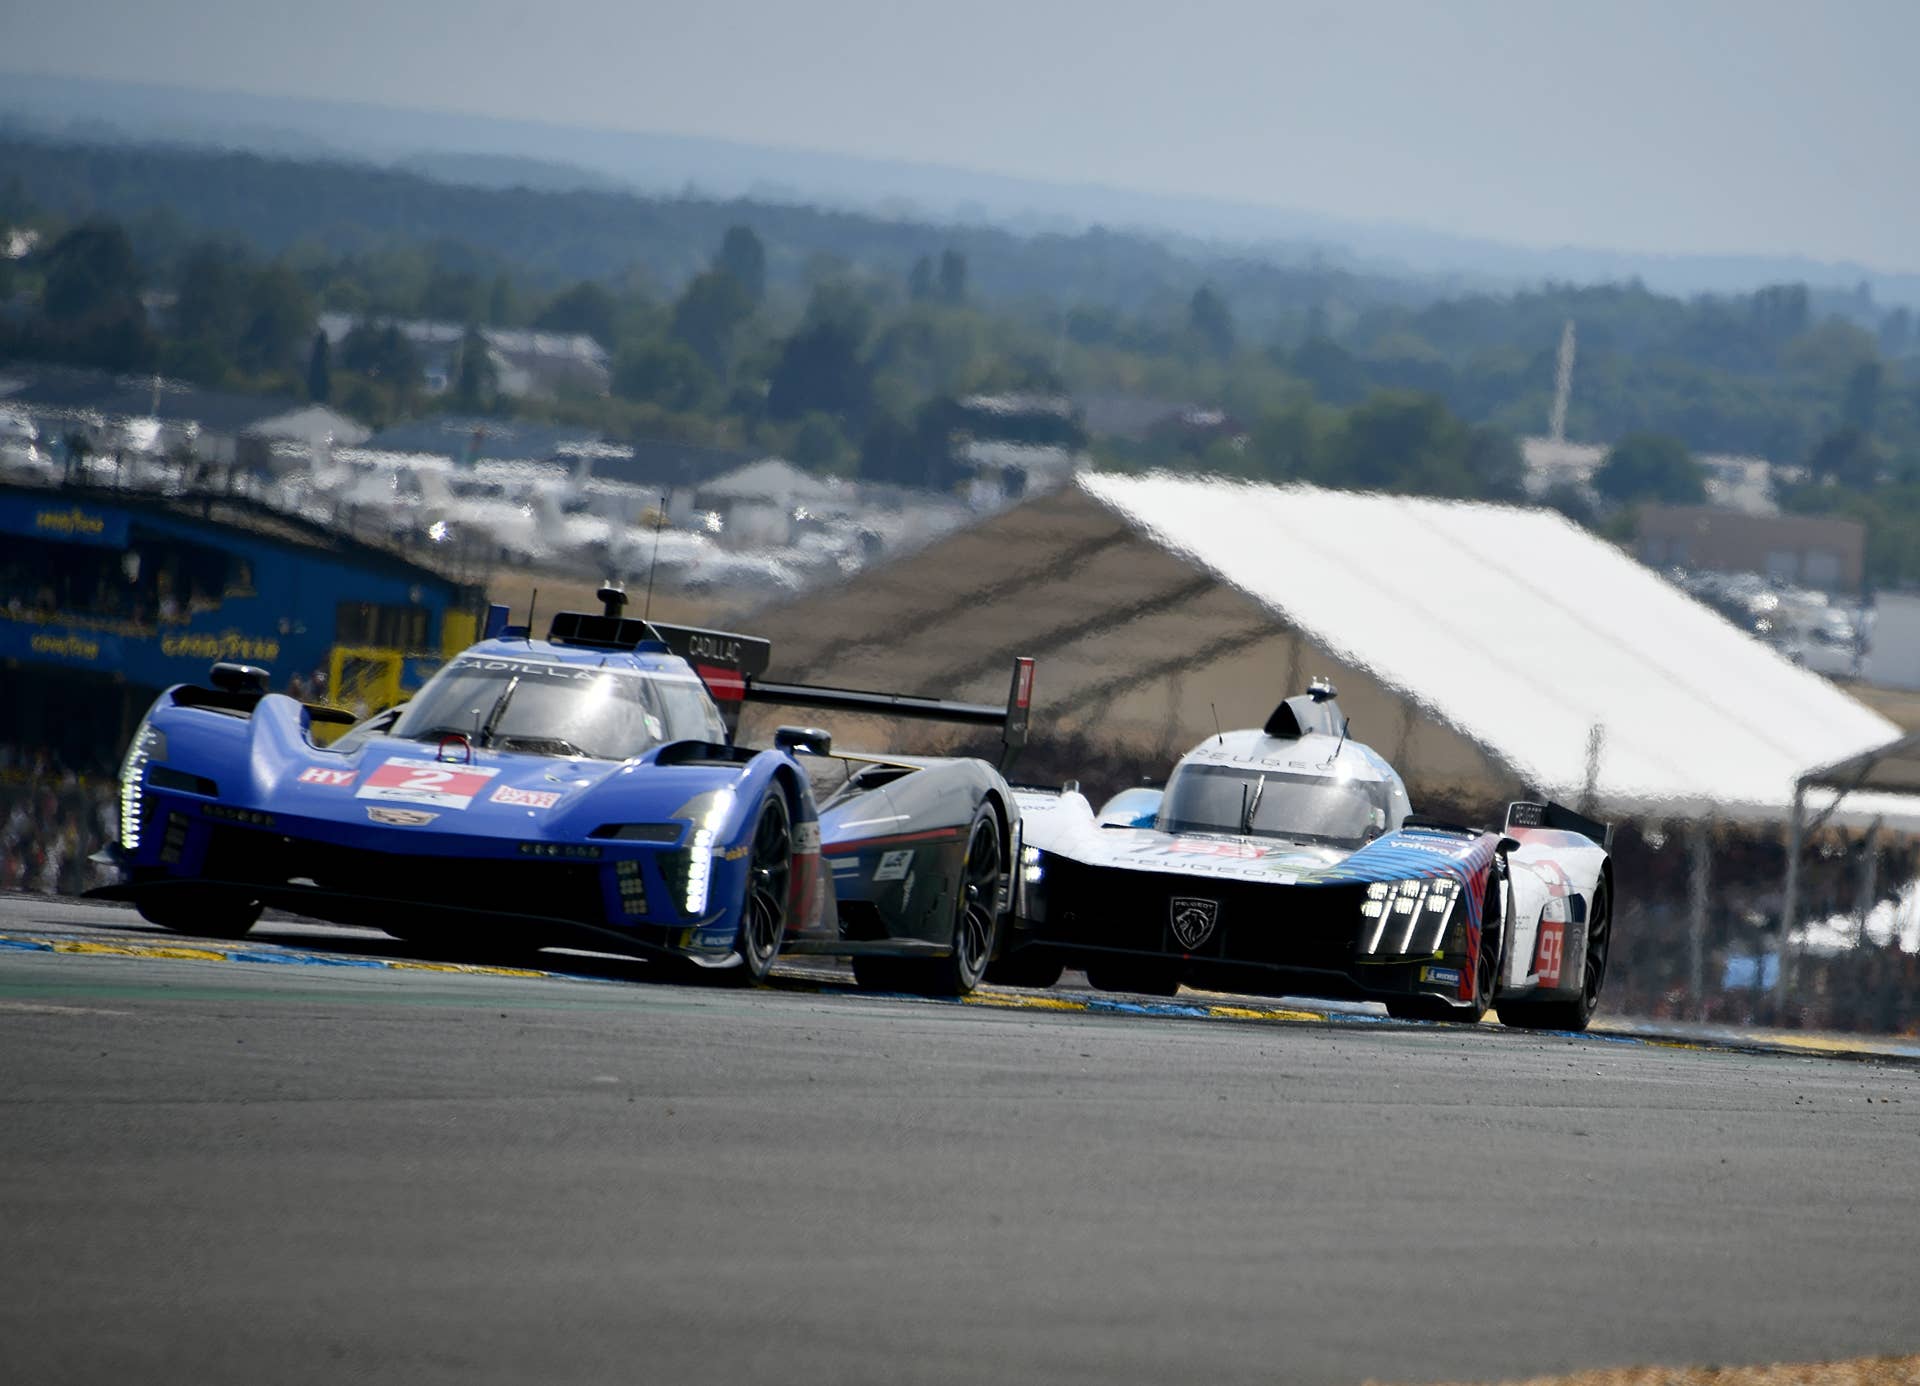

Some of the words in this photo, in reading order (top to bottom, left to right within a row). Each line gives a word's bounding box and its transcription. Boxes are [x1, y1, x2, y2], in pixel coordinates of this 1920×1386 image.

[689, 635, 742, 663] CADILLAC
[449, 660, 612, 684] CADILLA
[1197, 749, 1340, 771] PEUGEO
[399, 770, 455, 792] 2
[1175, 901, 1214, 909] PEUGEOT
[1538, 930, 1564, 979] 93
